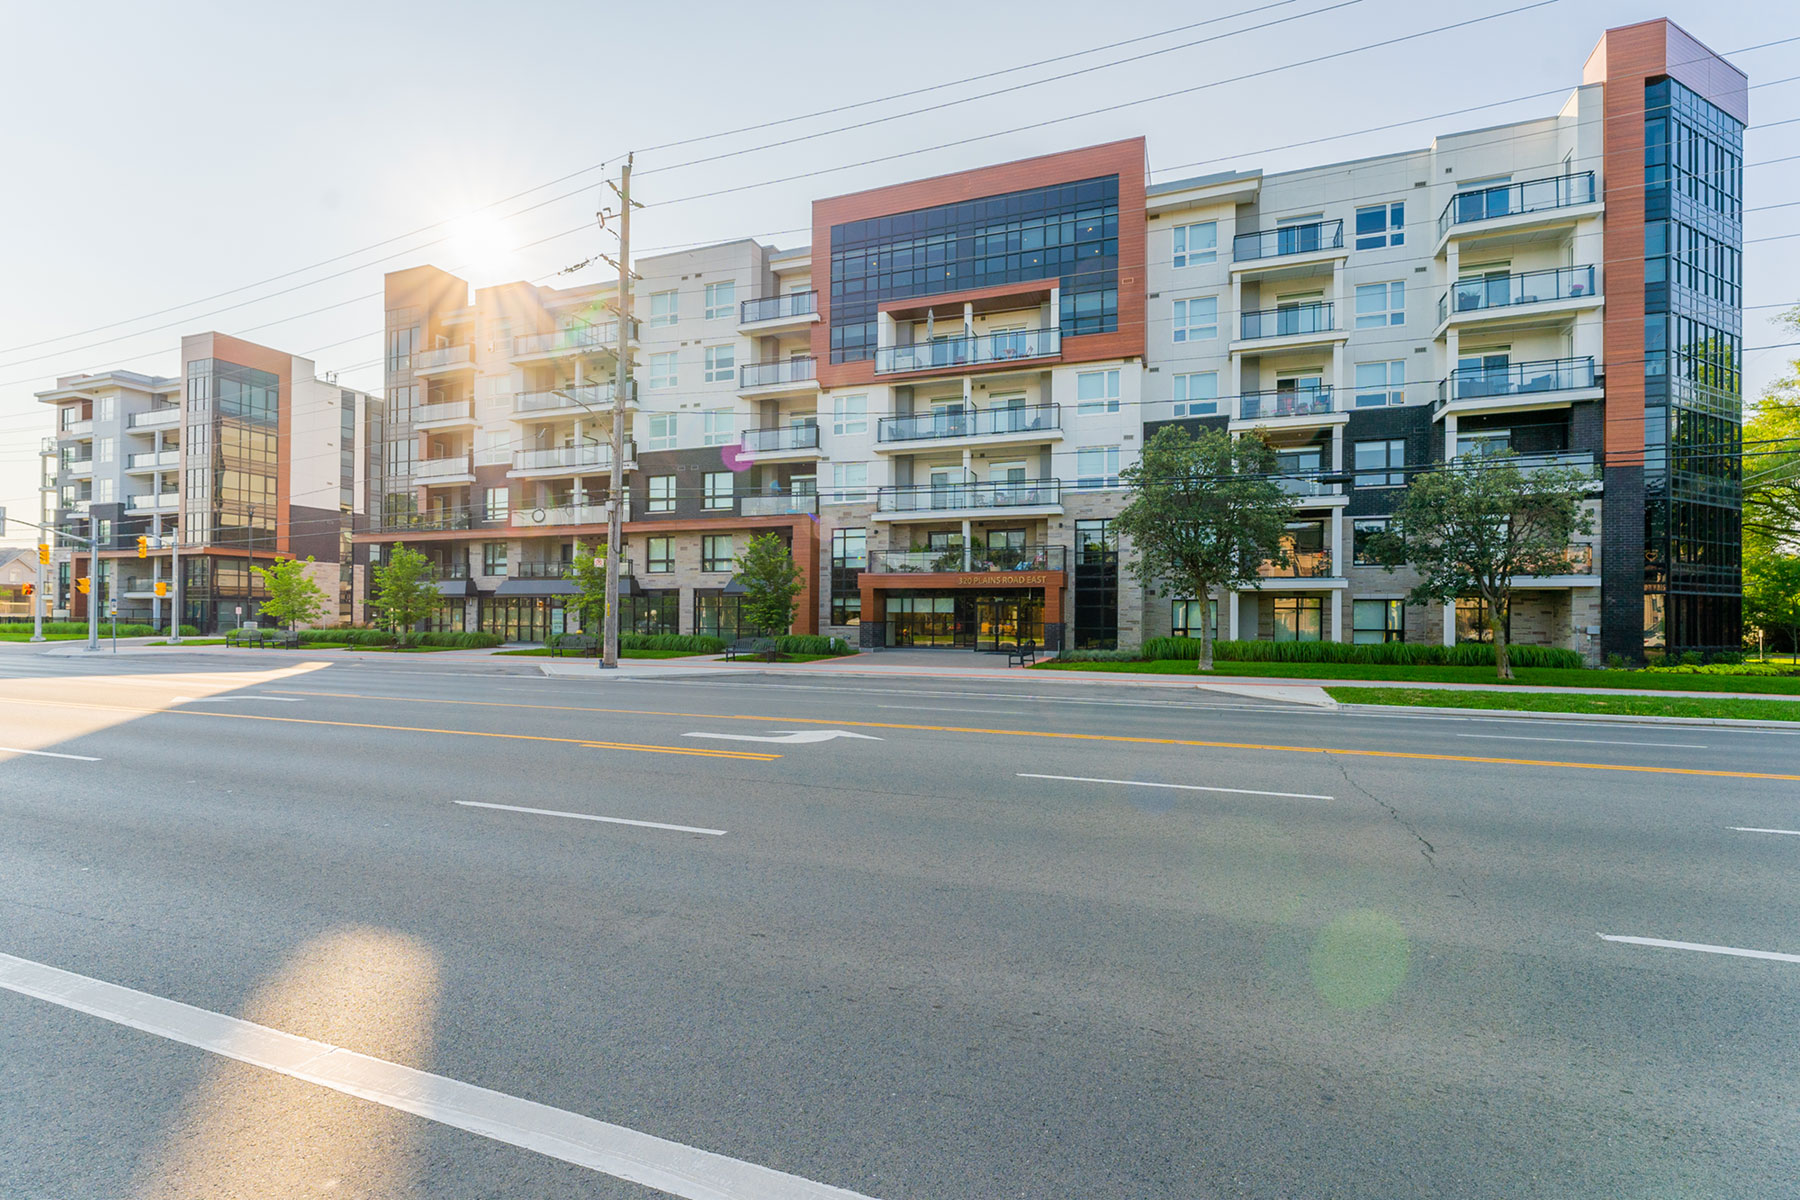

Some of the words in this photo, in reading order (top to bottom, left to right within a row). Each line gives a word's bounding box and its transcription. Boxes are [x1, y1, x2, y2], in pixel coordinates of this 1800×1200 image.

[973, 576, 1000, 584] PLAINS
[1002, 576, 1025, 584] ROAD
[1026, 575, 1047, 584] EAST
